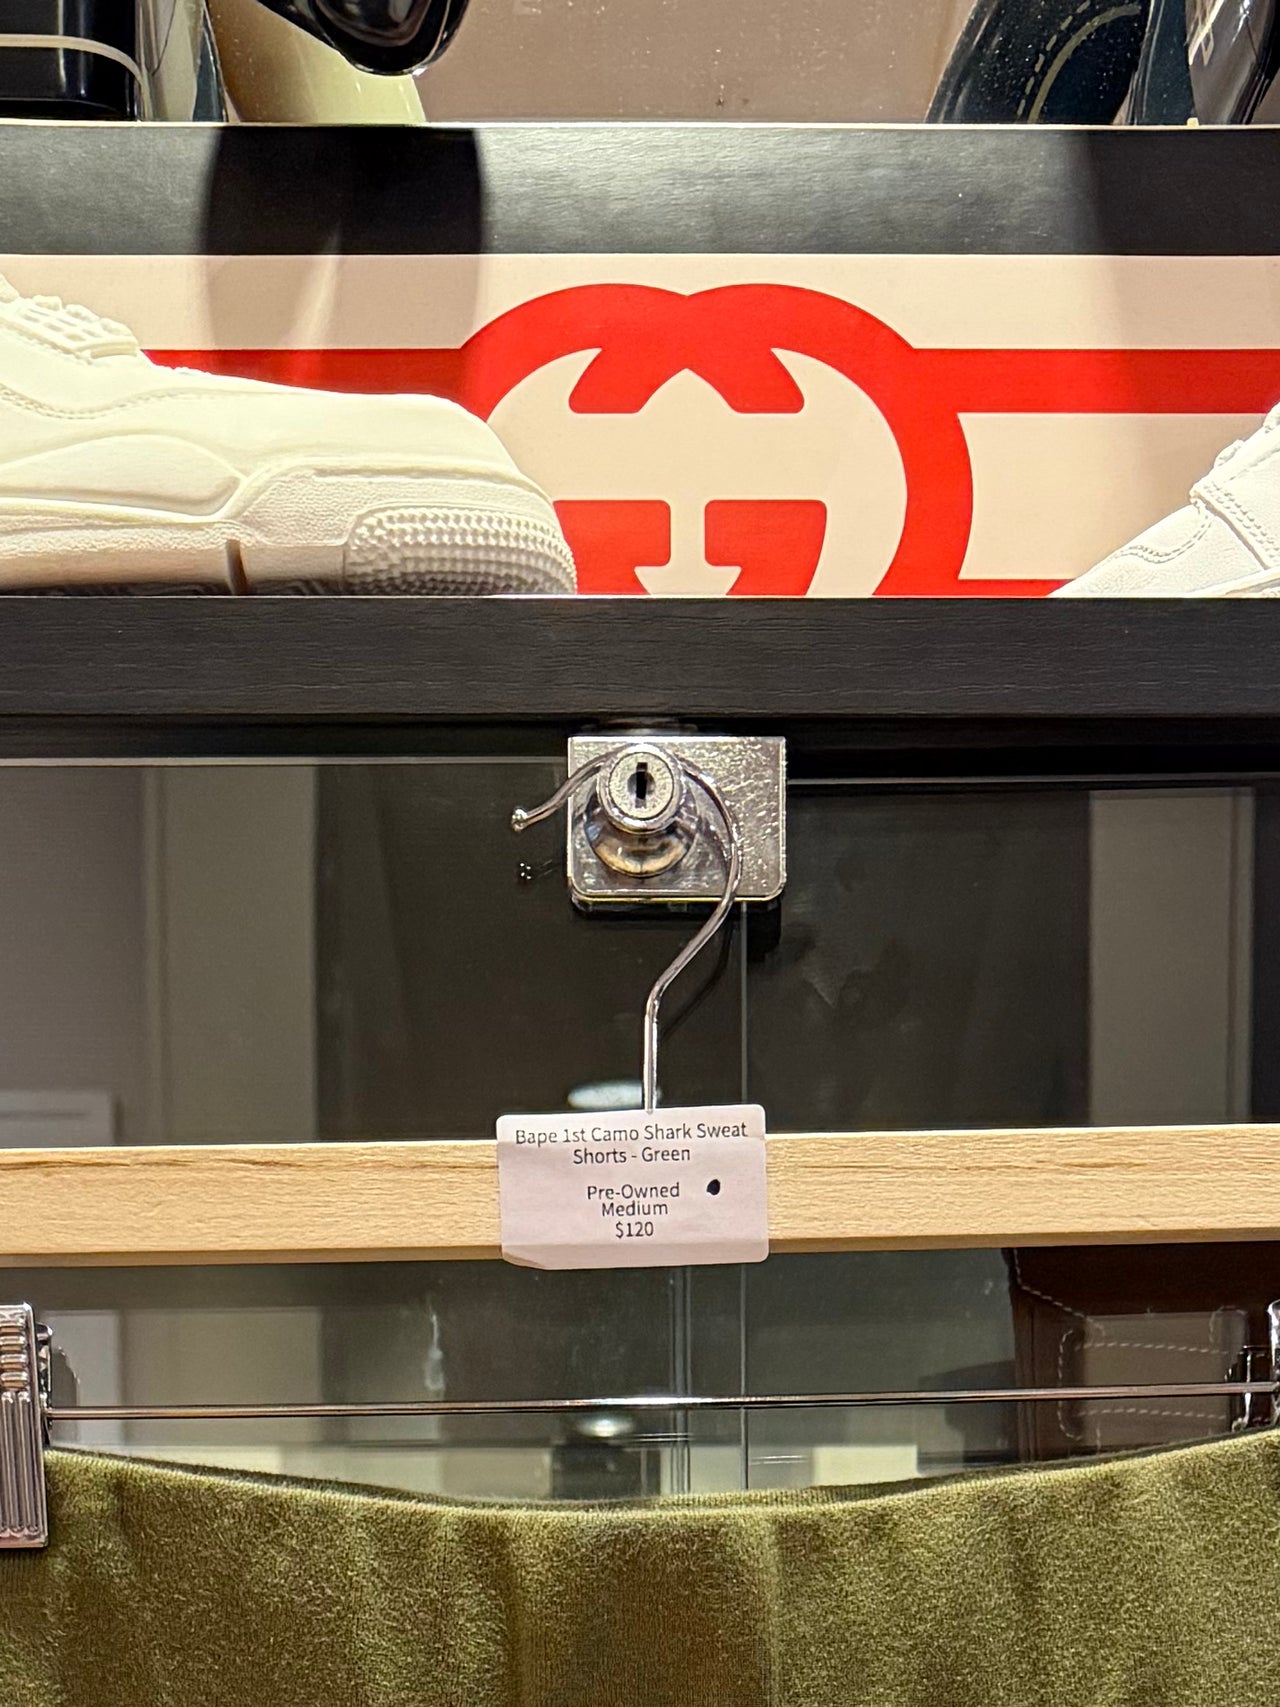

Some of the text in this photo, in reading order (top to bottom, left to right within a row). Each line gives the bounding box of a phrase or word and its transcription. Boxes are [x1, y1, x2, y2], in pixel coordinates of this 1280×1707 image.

[515, 1121, 748, 1148] Bape 1st Camo Shark Sweat
[573, 1147, 627, 1165] Shorts
[641, 1146, 691, 1163] Green
[586, 1181, 681, 1201] Pre-Owned
[601, 1200, 669, 1218] Medium
[615, 1220, 654, 1240] $120
